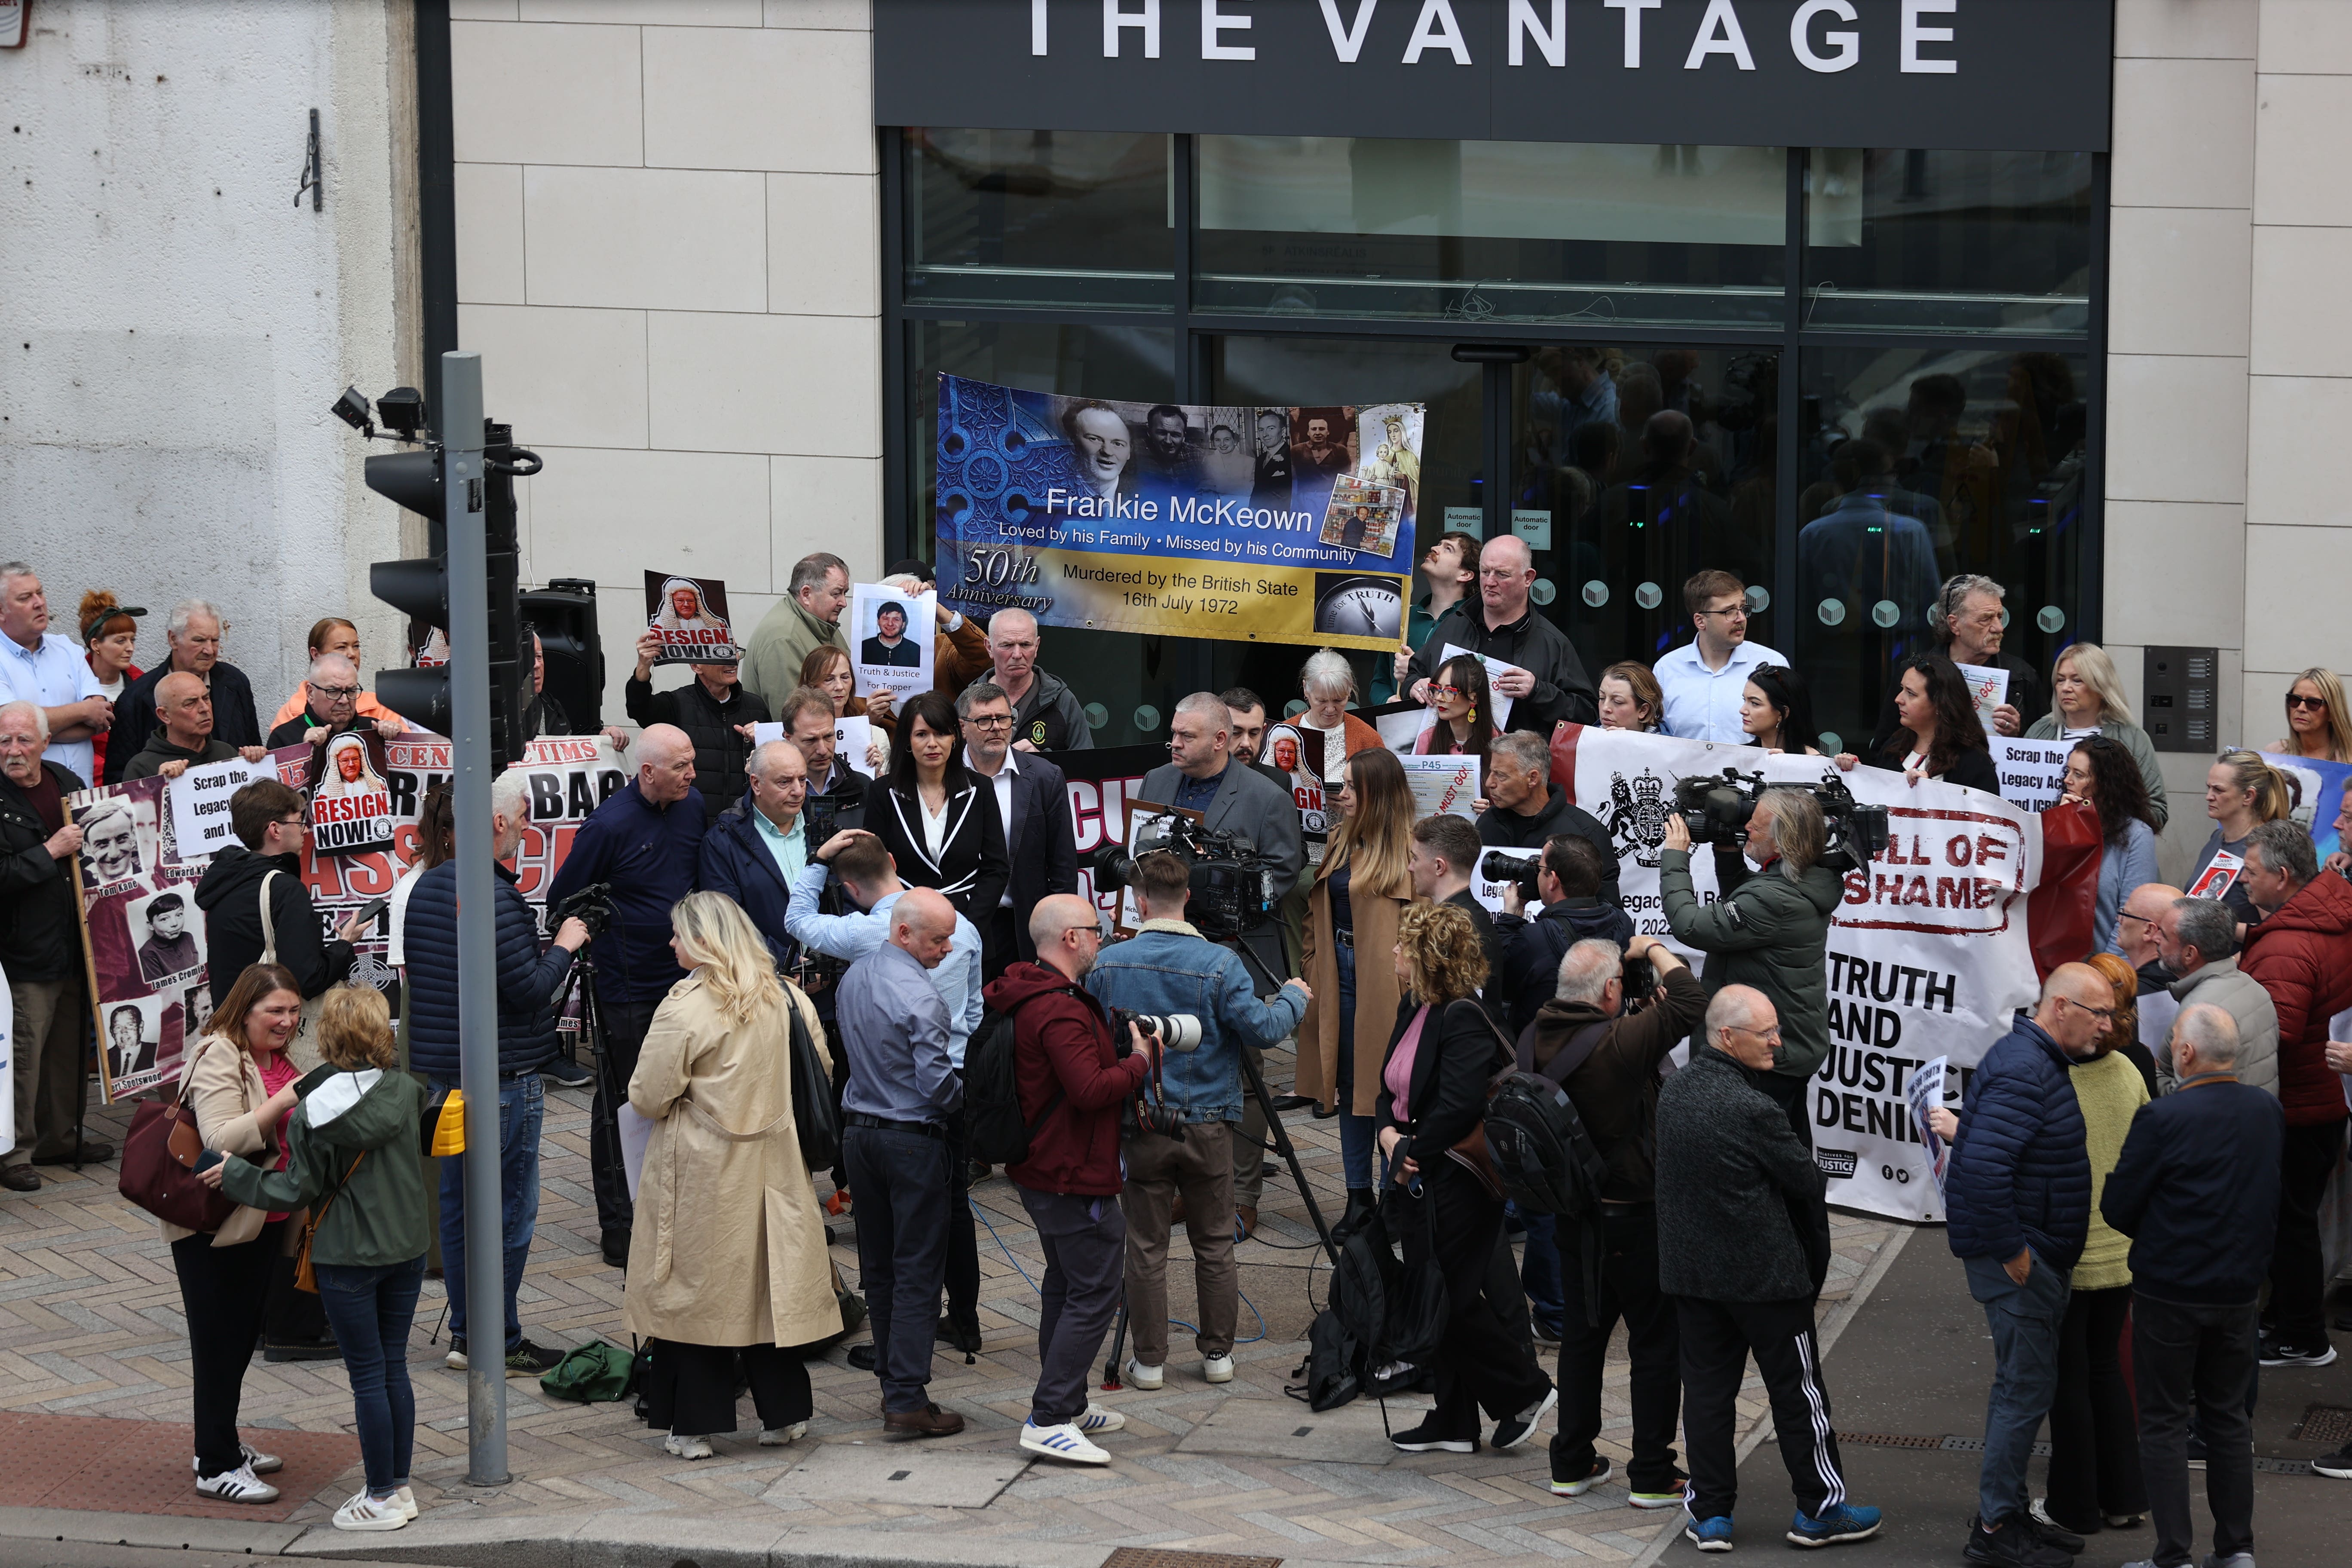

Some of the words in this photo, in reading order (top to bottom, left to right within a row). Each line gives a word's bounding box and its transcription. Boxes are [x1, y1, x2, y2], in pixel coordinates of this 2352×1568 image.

[1323, 0, 1959, 74] VANTAGE
[1047, 488, 1158, 520] Frankie
[1170, 496, 1312, 532] McKeown
[1000, 522, 1044, 539] Loved
[1050, 530, 1068, 544] by
[1073, 529, 1094, 543] his
[1100, 530, 1150, 550] Family
[1166, 535, 1219, 552] Missed
[1225, 539, 1242, 557] by
[1247, 539, 1268, 555] his
[1272, 543, 1357, 564] Community
[965, 550, 1038, 586] 50th
[1064, 564, 1142, 585] Murdered
[1148, 571, 1167, 589] by
[1173, 573, 1197, 588] the
[1202, 575, 1251, 593] British
[1257, 580, 1298, 596] State
[945, 583, 1052, 613] Anniversary
[1123, 592, 1157, 608] 16th
[1162, 595, 1194, 614] July
[1200, 598, 1238, 614] 1972
[1327, 609, 1337, 628] time
[1334, 600, 1347, 610] for
[1345, 590, 1396, 603] TRUTH
[649, 628, 729, 645] RESIGN
[859, 667, 880, 677] Truth
[883, 668, 890, 677] &
[892, 669, 920, 679] Justice
[867, 681, 879, 690] For
[883, 682, 912, 693] Topper
[277, 764, 305, 786] 15
[525, 739, 598, 764] CTIMS
[1422, 761, 1441, 769] P45
[2006, 747, 2040, 764] Scrap
[2045, 750, 2064, 764] the
[194, 772, 226, 791] Scrap
[230, 769, 248, 784] the
[1439, 785, 1458, 813] MUST
[1454, 766, 1469, 786] GO!
[2001, 772, 2043, 790] Legacy
[2047, 776, 2063, 790] Ac
[194, 799, 232, 816] Legacy
[314, 792, 387, 824] RESIGN
[204, 824, 226, 840] and
[316, 820, 372, 848] NOW!
[1618, 845, 1633, 857] DIEU
[1945, 834, 2008, 867] OF
[166, 867, 194, 879] Edward
[197, 867, 208, 877] Ka
[99, 886, 117, 897] Tom
[118, 879, 138, 892] Kane
[1482, 883, 1504, 898] Lega
[1844, 873, 2002, 910] SHAME
[1621, 894, 1663, 913] egac
[151, 975, 177, 990] James
[179, 964, 205, 982] Cromie
[1828, 951, 1956, 1014] TRUTH
[560, 1019, 578, 1028] mes
[1828, 998, 1902, 1049] AND
[122, 1072, 162, 1089] Spotswood
[1818, 1158, 1854, 1171] JUSTICE
